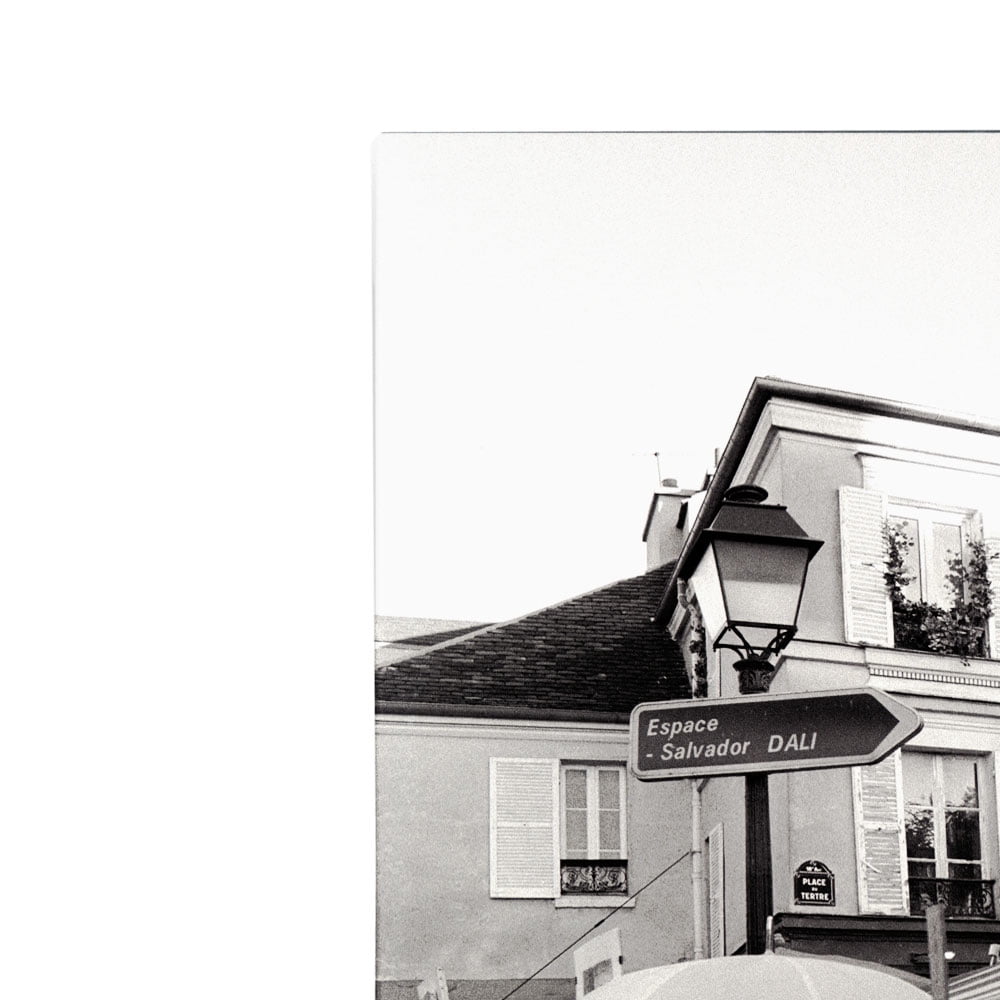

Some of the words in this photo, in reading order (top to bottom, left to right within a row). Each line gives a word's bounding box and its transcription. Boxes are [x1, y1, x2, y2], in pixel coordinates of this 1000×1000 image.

[647, 718, 719, 741] Espace
[660, 738, 750, 761] Salvador
[768, 732, 817, 753] DALI
[802, 877, 826, 886] PLACE
[801, 892, 829, 900] TERTRE
